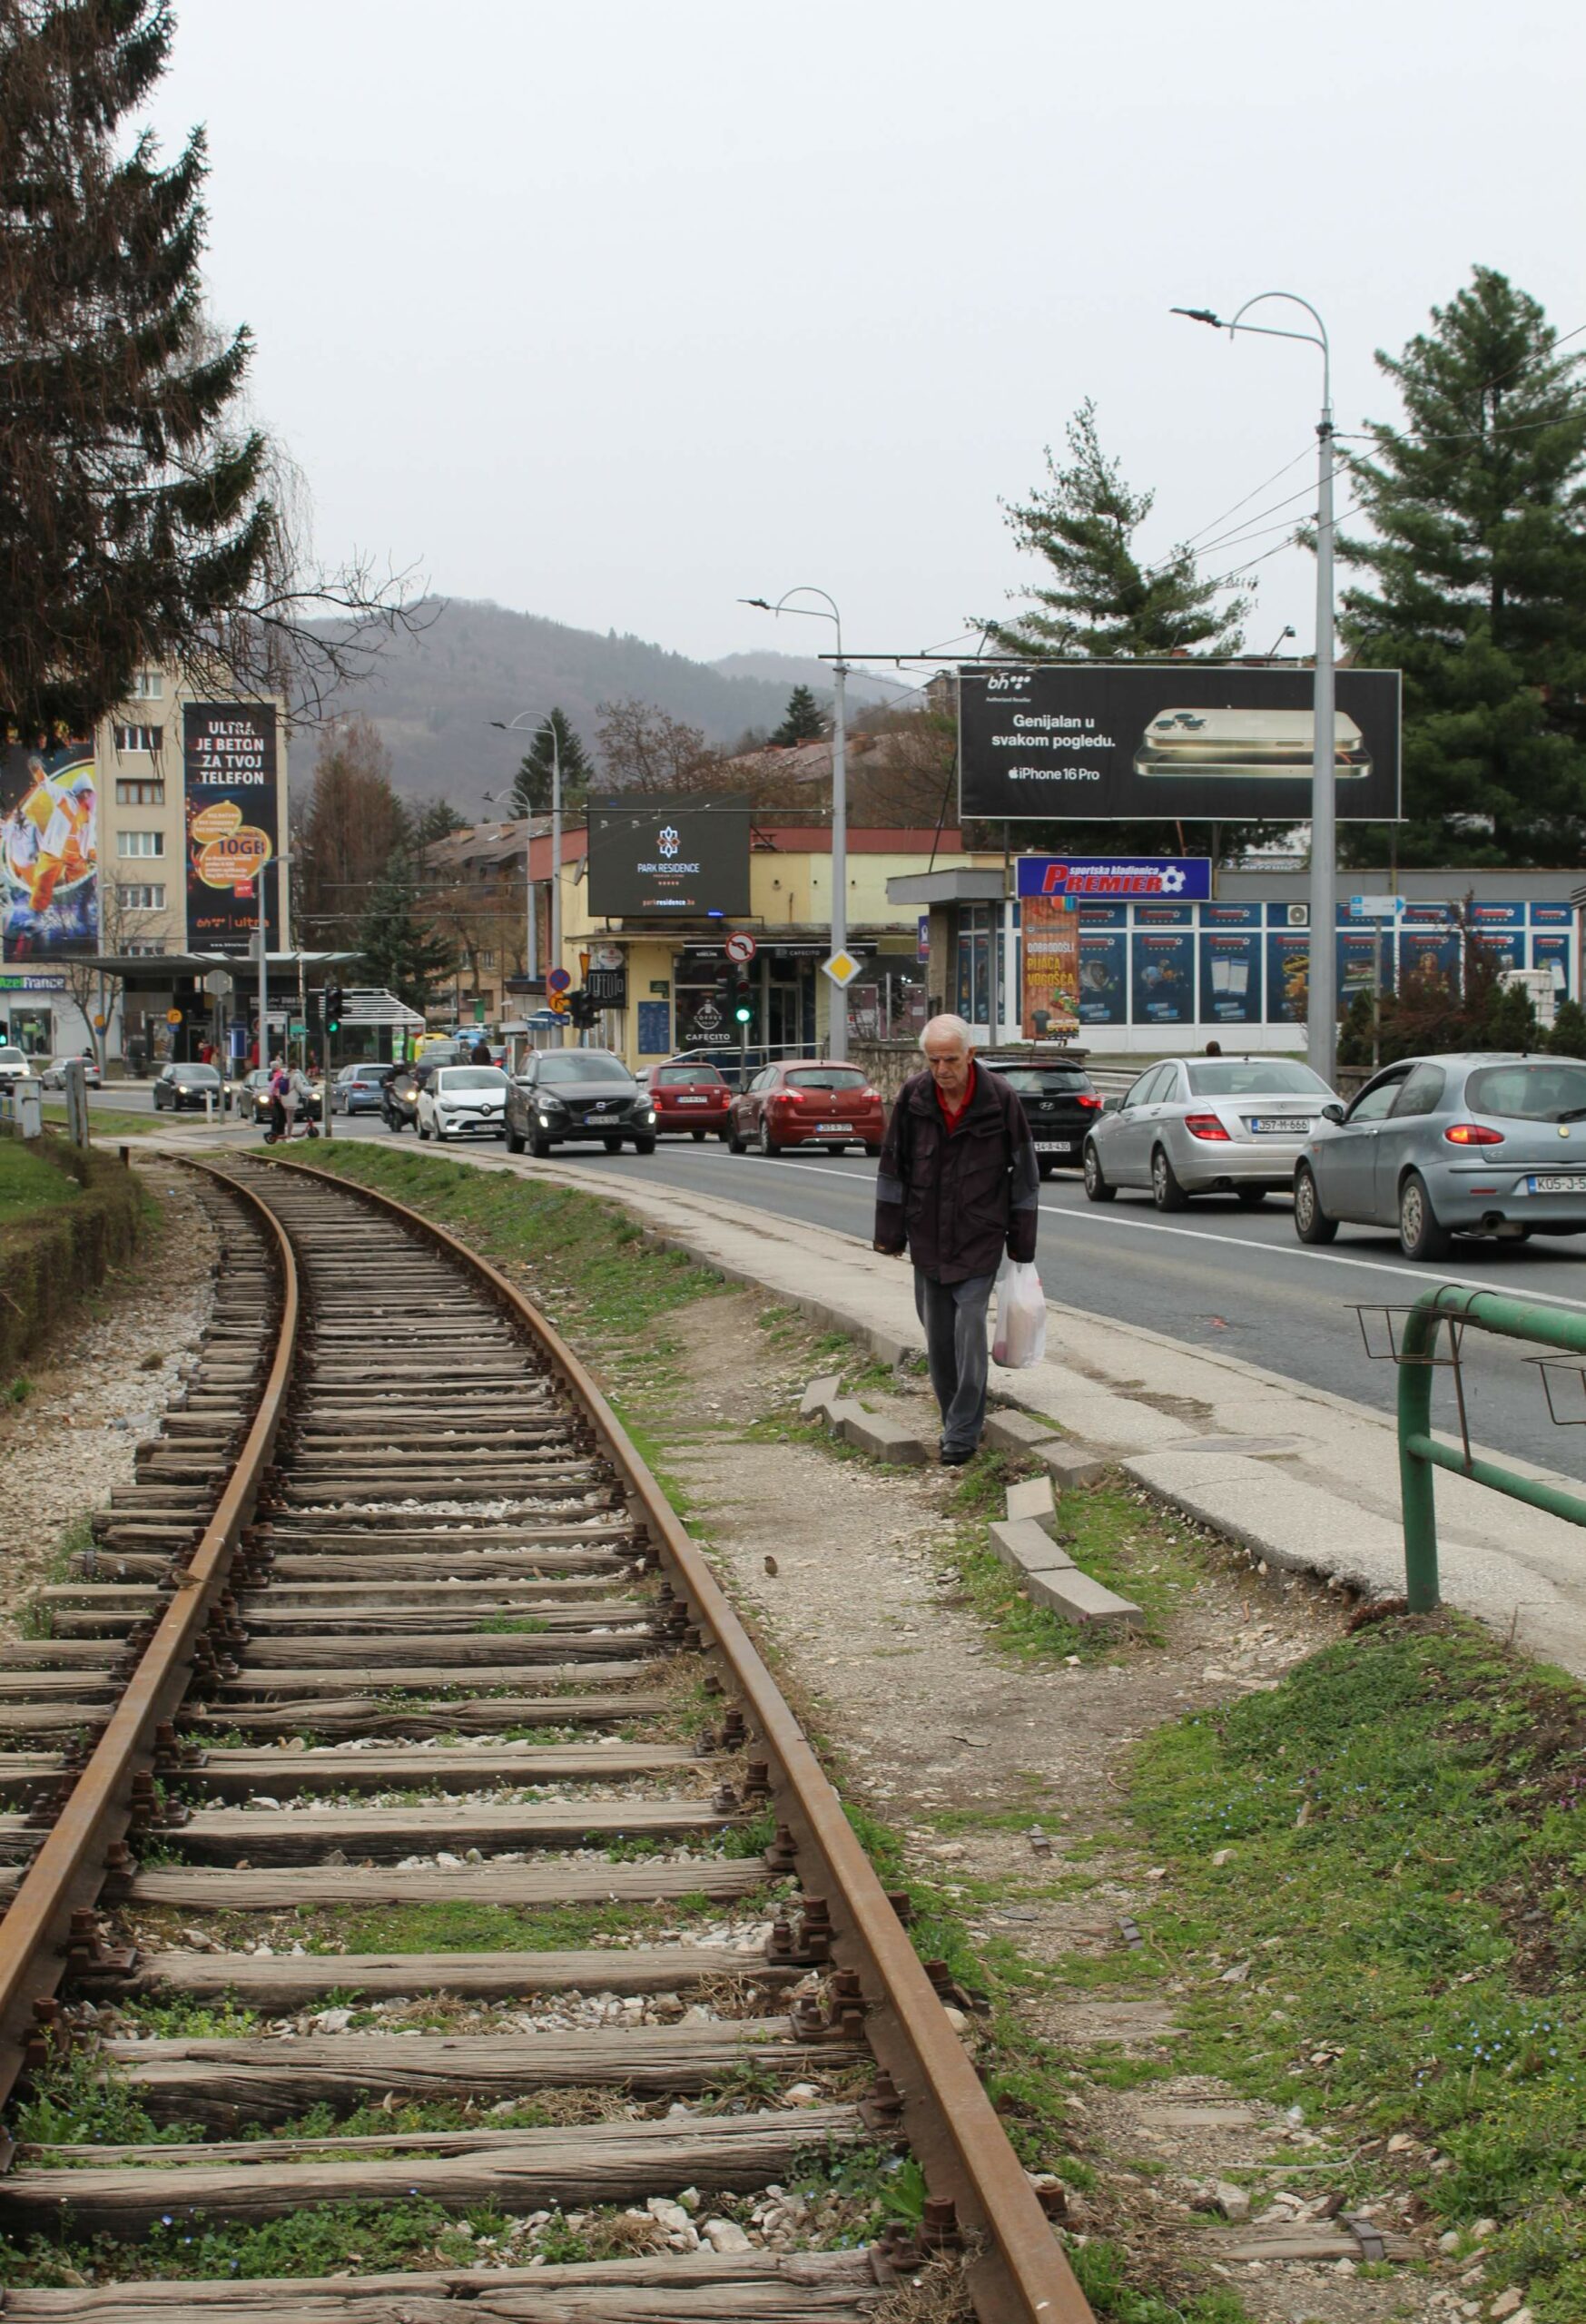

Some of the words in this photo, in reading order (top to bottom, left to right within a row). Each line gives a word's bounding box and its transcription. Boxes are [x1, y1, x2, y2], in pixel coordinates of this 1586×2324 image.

[208, 721, 256, 735] ULTRA
[1013, 714, 1081, 730] Genijalan
[1085, 717, 1095, 728] u
[196, 737, 212, 751] JE
[216, 737, 264, 752] BETON
[991, 733, 1049, 746] svakom
[1052, 734, 1116, 750] pogledu.
[202, 754, 222, 767] ZA
[225, 754, 261, 768] TVOJ
[201, 771, 264, 785] TELEFON
[1019, 767, 1061, 781] iPhone
[1063, 768, 1077, 781] 16
[1079, 768, 1100, 781] Pro
[219, 838, 264, 855] 10GB
[637, 862, 657, 872] PARK
[658, 862, 700, 873] RESIDENCE
[1069, 866, 1109, 875] sportska
[1111, 865, 1159, 875] kladionica
[1041, 864, 1163, 893] PREMIER
[685, 1033, 731, 1041] CAFECITO
[1258, 1119, 1307, 1130] J57-M-666
